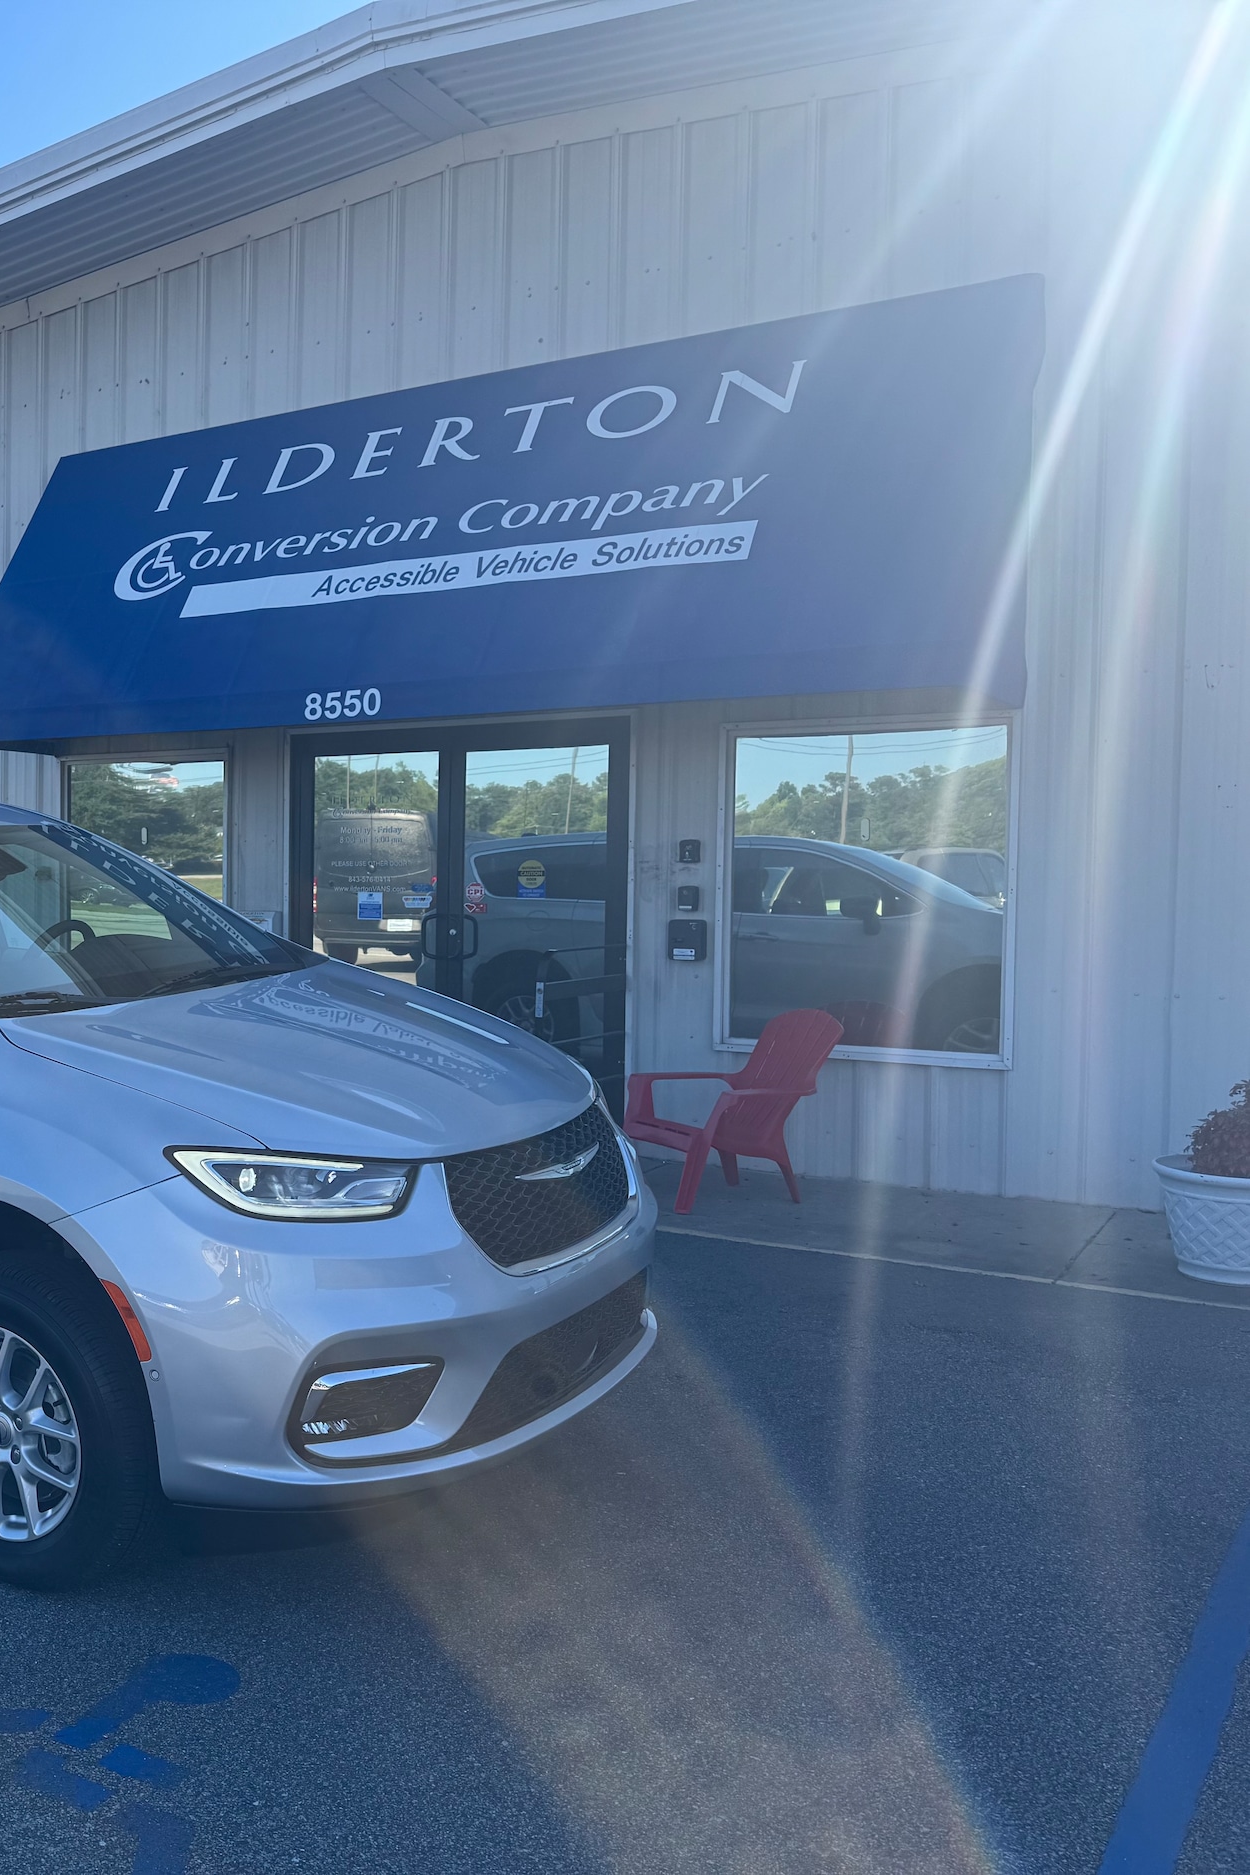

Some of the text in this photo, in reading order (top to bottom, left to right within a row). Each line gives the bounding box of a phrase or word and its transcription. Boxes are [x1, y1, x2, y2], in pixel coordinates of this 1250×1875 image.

[154, 359, 808, 514] ILDERTON
[113, 473, 770, 602] Conversion Company
[310, 533, 746, 599] Accessible Vehicle Solutions
[304, 688, 382, 721] 8550
[378, 825, 403, 836] Friday
